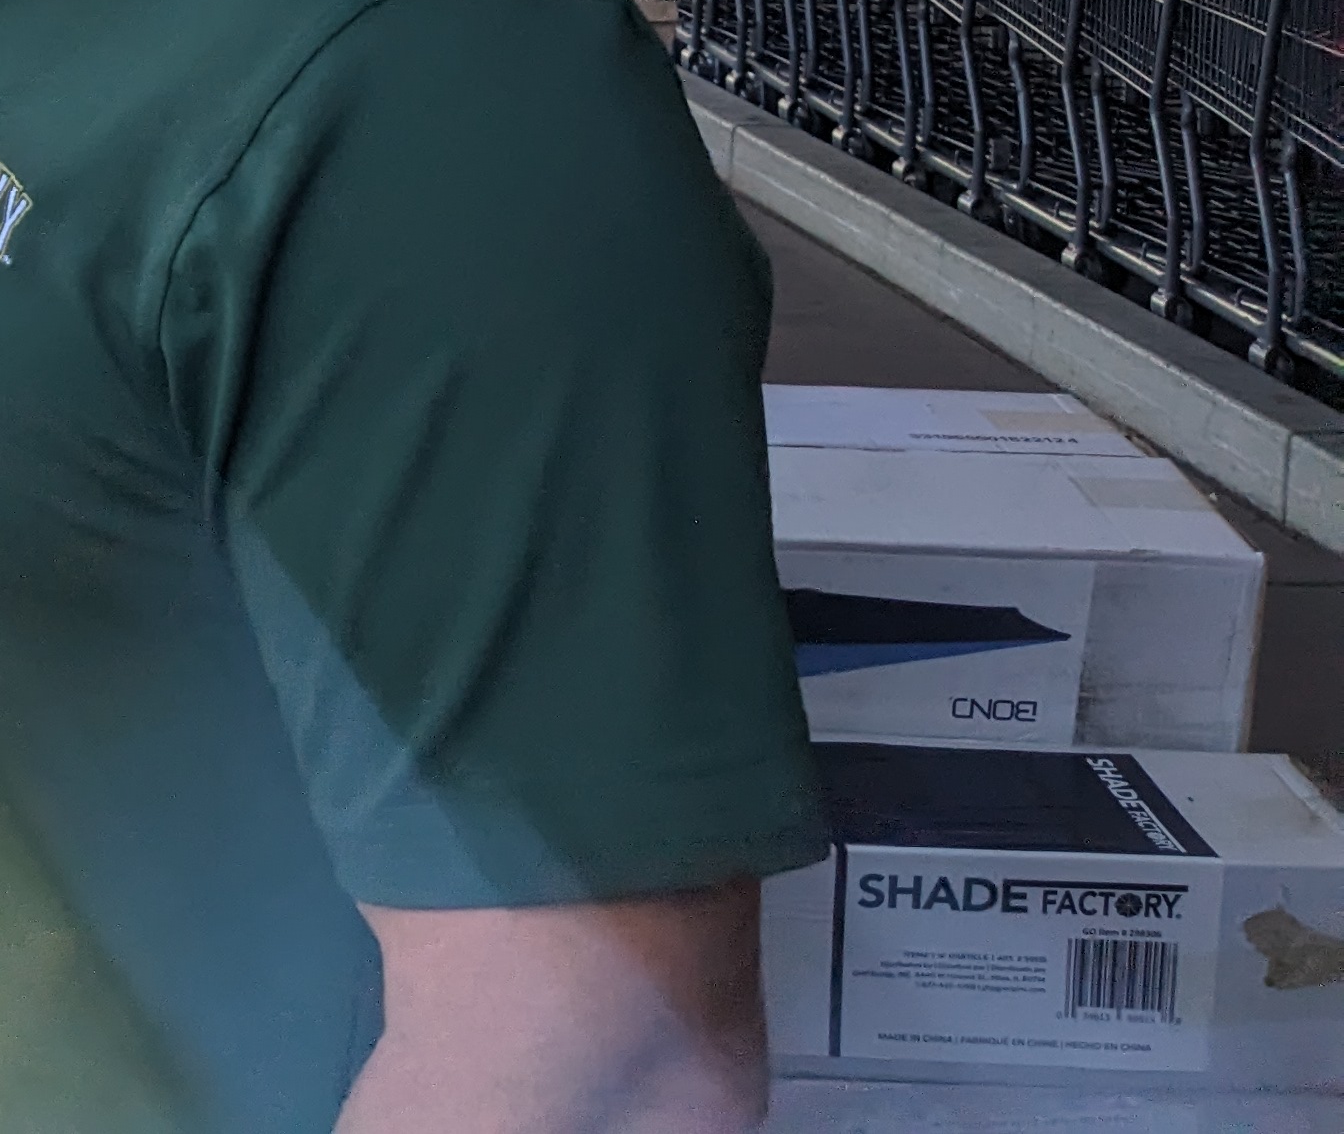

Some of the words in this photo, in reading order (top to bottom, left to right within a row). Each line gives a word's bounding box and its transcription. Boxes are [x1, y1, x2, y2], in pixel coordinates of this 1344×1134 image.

[1086, 757, 1144, 808] SHADE
[857, 873, 1029, 914] SHADE
[878, 1033, 905, 1041] MADE
[923, 1034, 952, 1043] CHINA
[1065, 1041, 1101, 1050] HECHO
[1104, 1042, 1118, 1050] EN
[1120, 1043, 1151, 1052] CHINA
